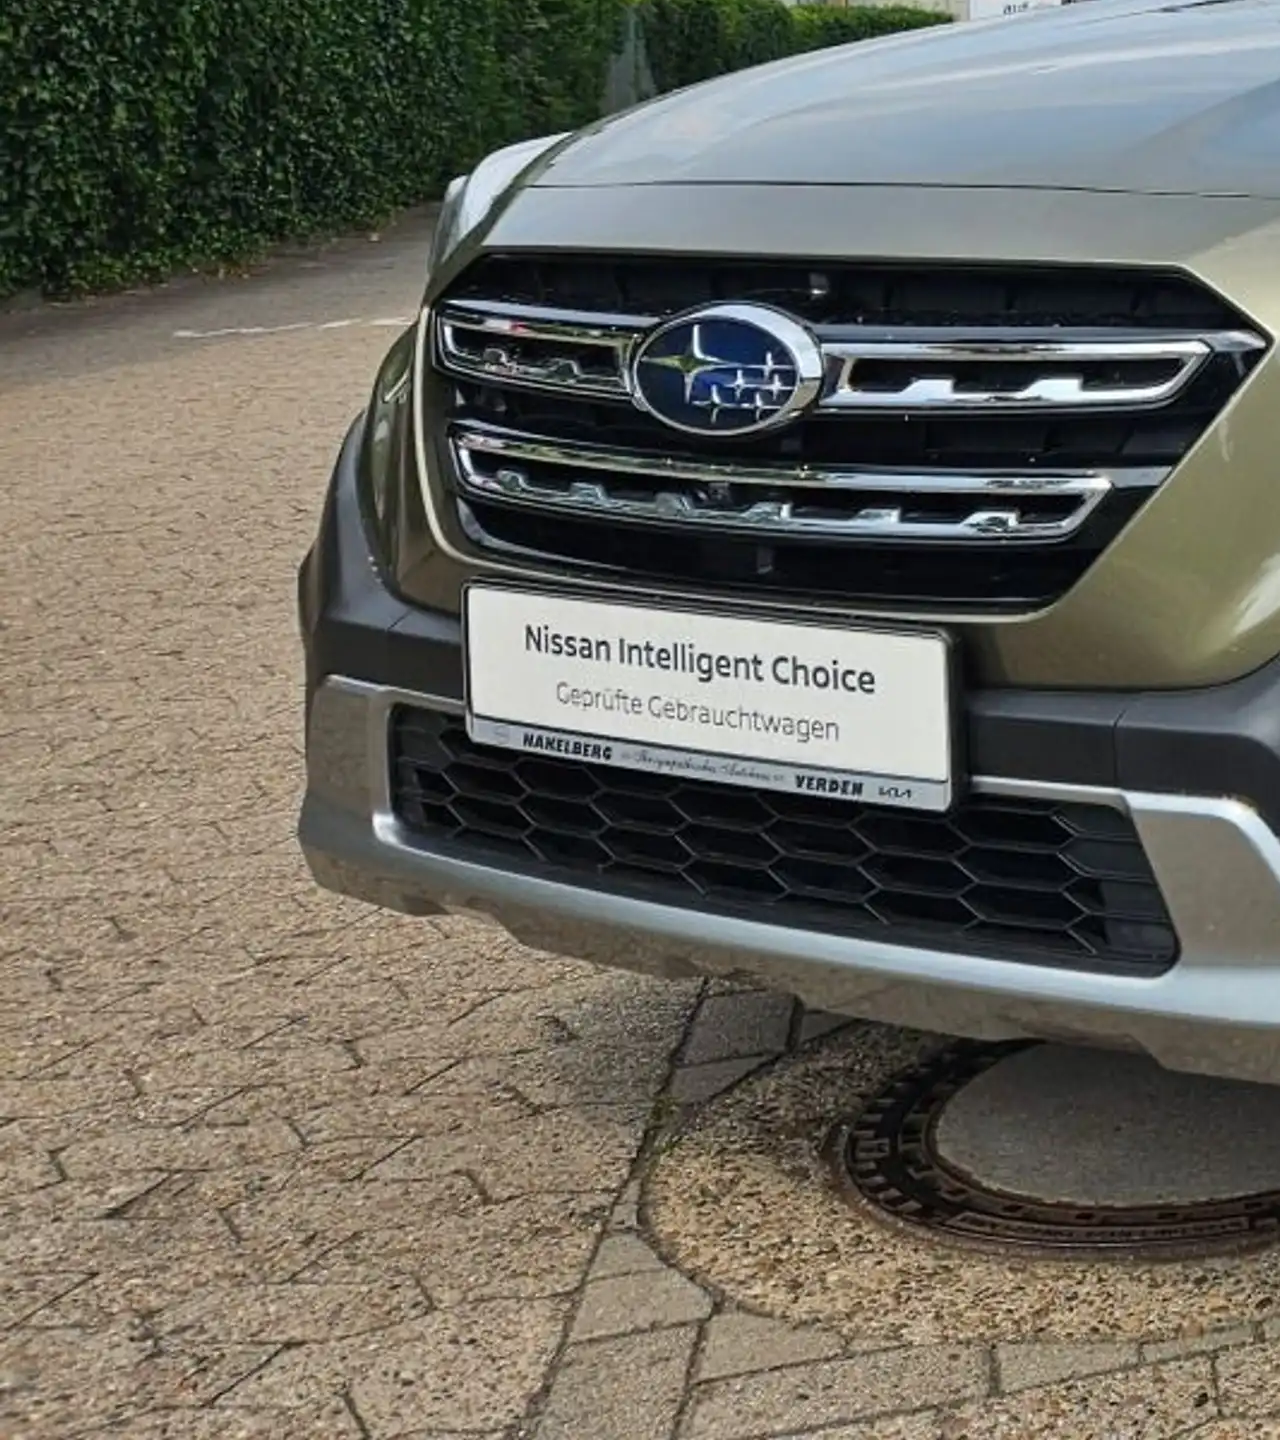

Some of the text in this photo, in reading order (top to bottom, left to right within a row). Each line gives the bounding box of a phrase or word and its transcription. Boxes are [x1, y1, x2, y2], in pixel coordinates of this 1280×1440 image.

[525, 623, 877, 696] Nissan Intelligent Choice
[556, 681, 840, 744] Geprüfte Gebrauchtwagen
[523, 732, 613, 761] HAKELBERG
[795, 774, 864, 797] VERDEN
